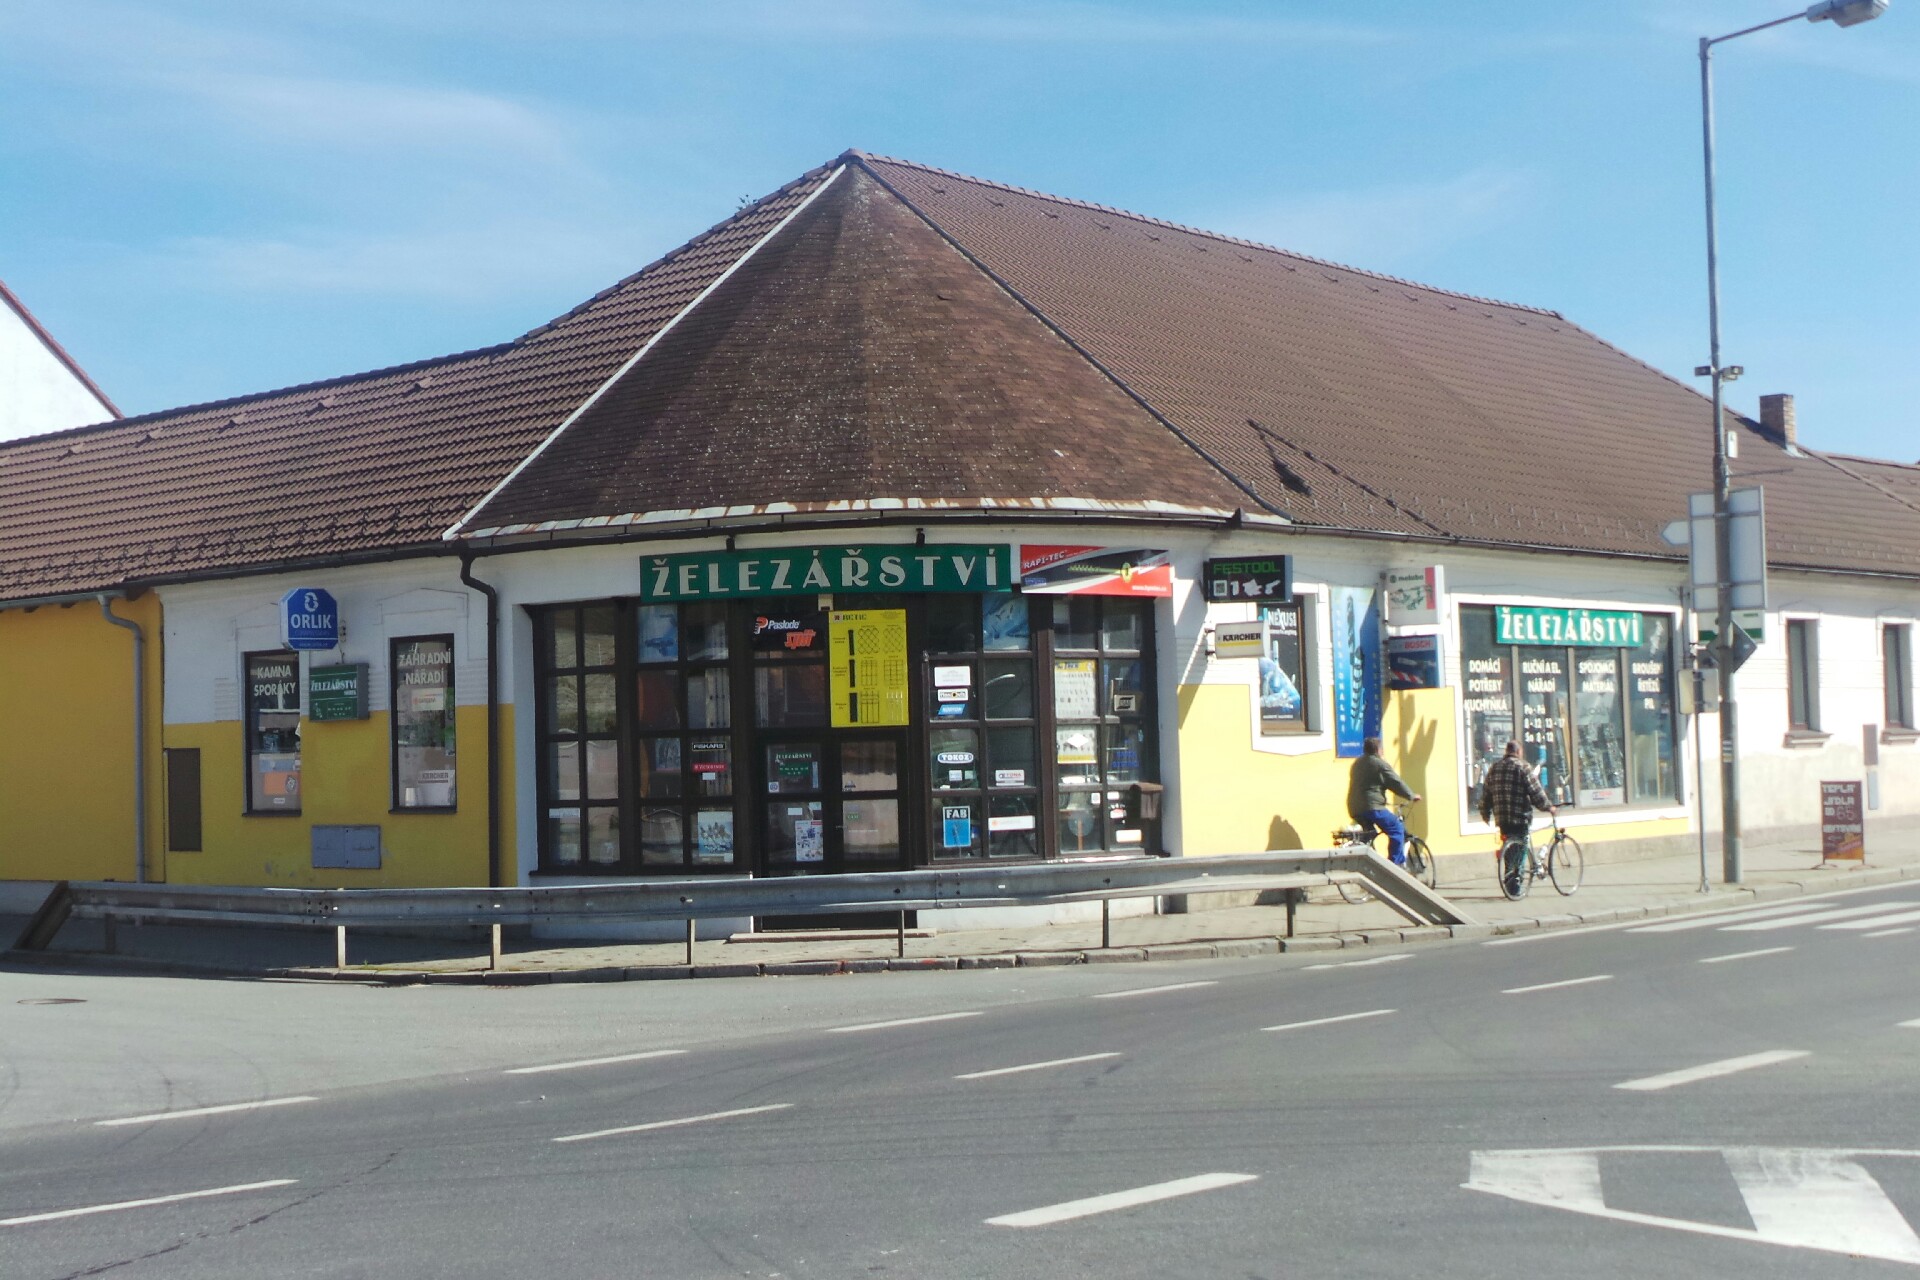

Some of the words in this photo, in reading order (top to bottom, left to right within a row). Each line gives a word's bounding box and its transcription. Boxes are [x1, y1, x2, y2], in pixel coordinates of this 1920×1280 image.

[652, 548, 997, 597] ŽELEZÁŘSTVÍ
[1213, 560, 1281, 575] FESTOOL
[290, 614, 332, 629] ORLIK
[767, 619, 800, 630] Paslode
[1501, 607, 1639, 642] ŽELEZÁŘSTVÍ
[1404, 640, 1431, 649] BOSCH
[400, 649, 451, 666] ZAHRADNÍ
[257, 665, 291, 679] KAMNA
[1469, 658, 1501, 673] DOMÁCÍ
[405, 668, 444, 685] NÁŘADÍ
[254, 680, 296, 697] SPORÁKY
[1469, 677, 1502, 692] POTŘEBY
[1528, 677, 1555, 693] NÁŘADÍ
[1464, 697, 1507, 712] KUCHYŇKA
[945, 809, 968, 819] FAB
